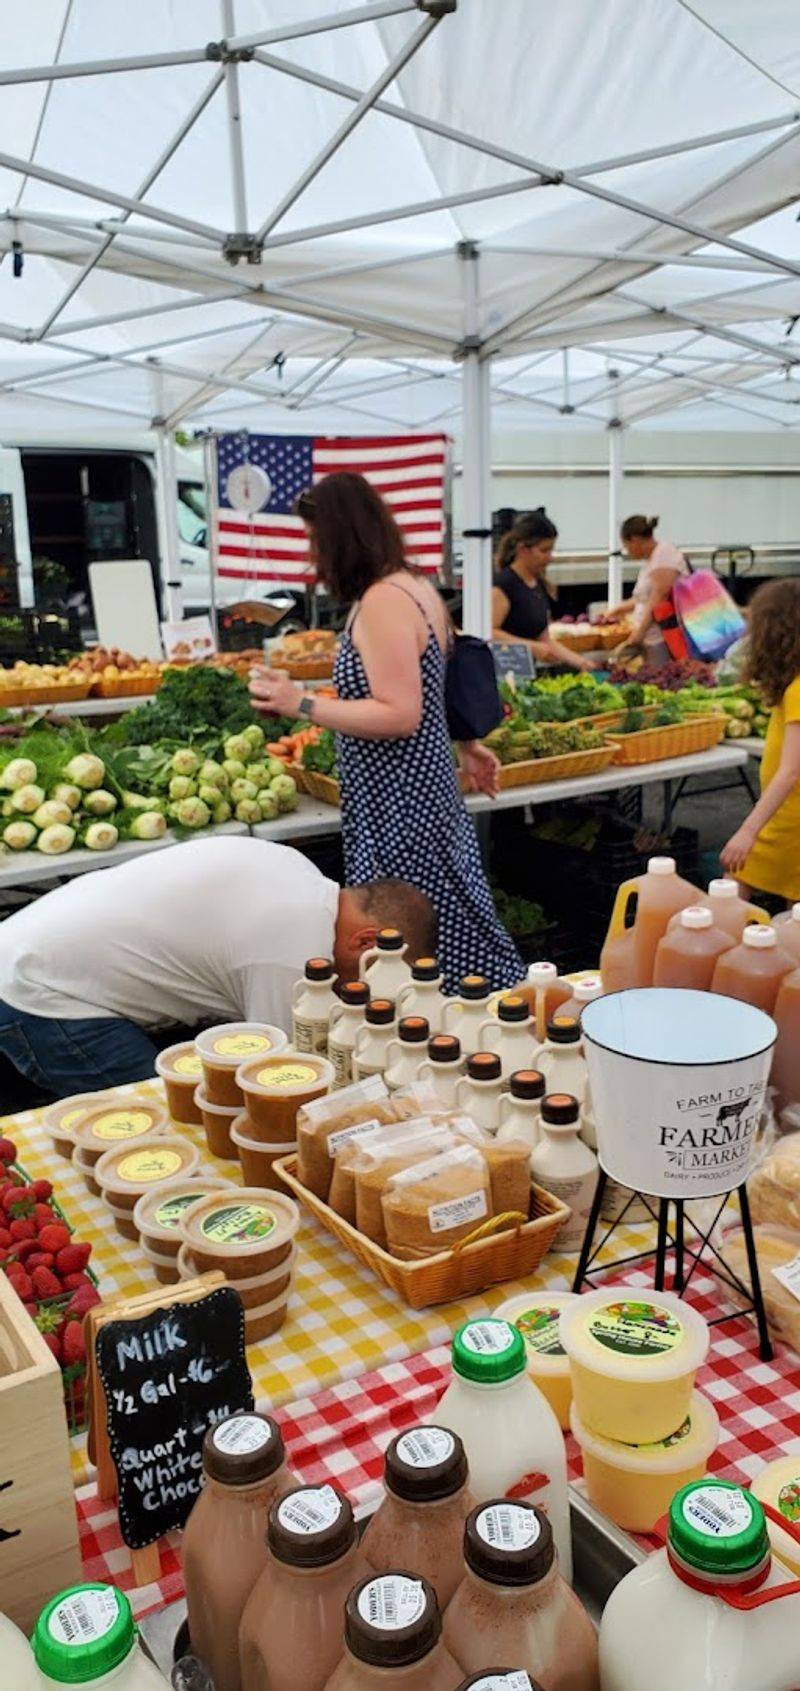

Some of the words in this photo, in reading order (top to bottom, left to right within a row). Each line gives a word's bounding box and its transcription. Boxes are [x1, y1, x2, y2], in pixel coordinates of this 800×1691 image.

[676, 1091, 722, 1110] FARM
[728, 1086, 745, 1099] TO
[657, 1115, 757, 1149] FARME
[116, 1319, 187, 1372] Milk
[121, 1426, 188, 1471] Quart
[133, 1450, 204, 1492] White
